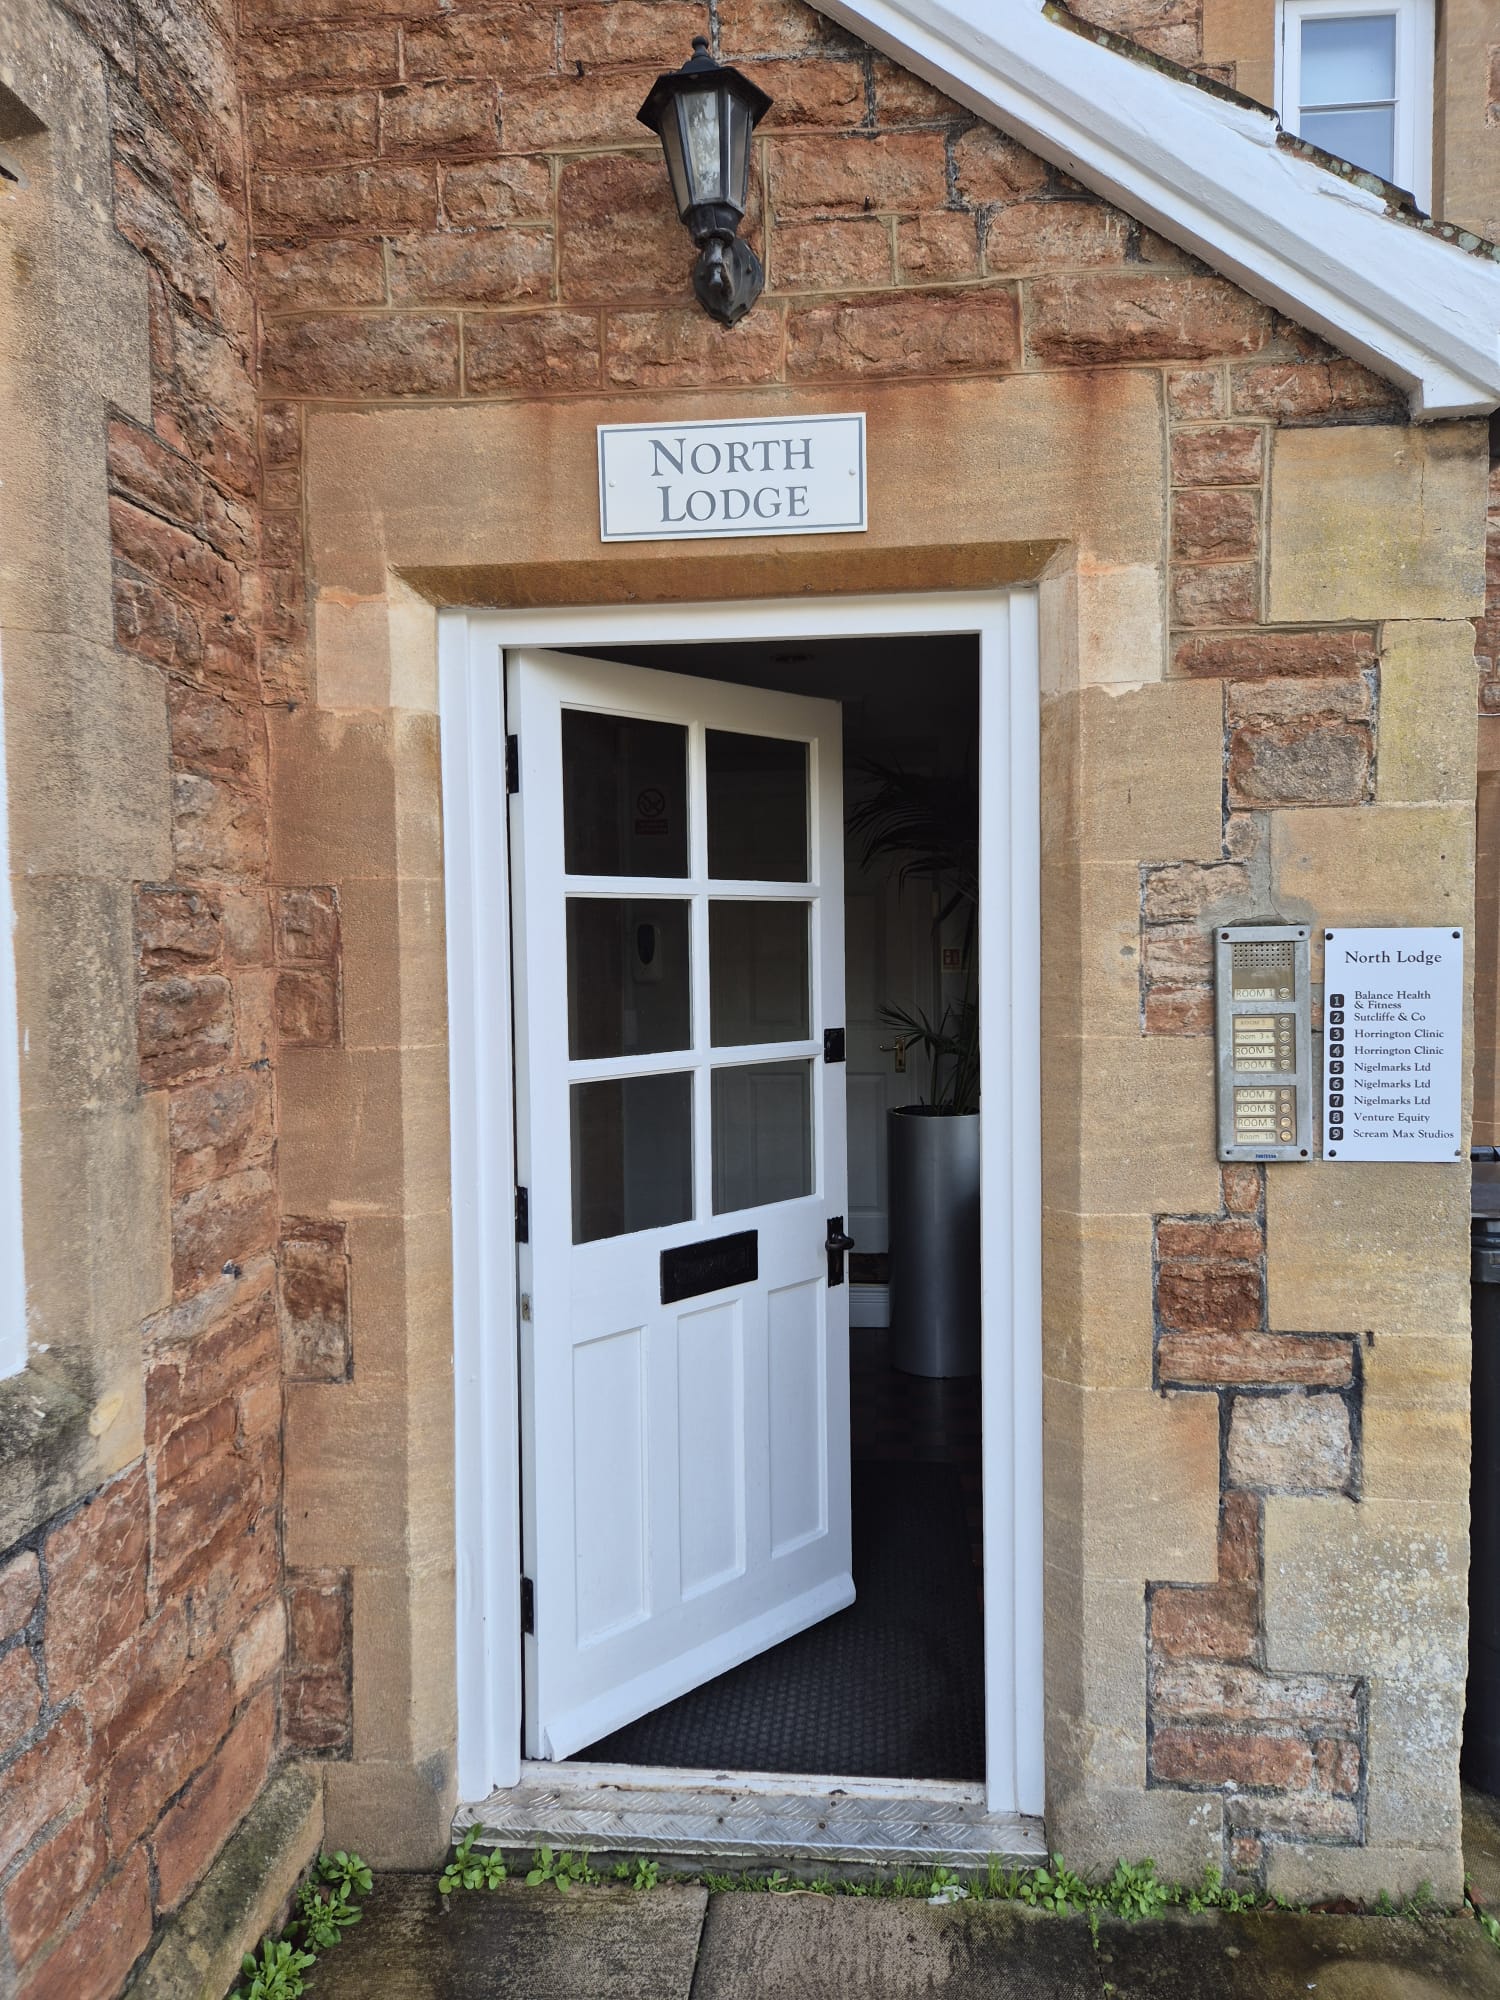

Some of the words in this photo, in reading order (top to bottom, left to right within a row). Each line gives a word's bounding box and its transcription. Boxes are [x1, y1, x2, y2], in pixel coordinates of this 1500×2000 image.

[648, 438, 815, 477] NORTH
[656, 485, 810, 523] LODGE
[1345, 950, 1390, 964] North
[1396, 950, 1442, 965] Lodge
[1236, 989, 1266, 998] ROOM
[1334, 996, 1341, 1006] 1
[1354, 991, 1393, 1000] Balance
[1397, 990, 1431, 1000] Health
[1354, 1000, 1363, 1009] &
[1368, 1000, 1402, 1009] Fitness
[1333, 1012, 1341, 1023] 2
[1354, 1012, 1395, 1021] Sutcliffe
[1398, 1013, 1408, 1021] &
[1411, 1012, 1426, 1021] Co
[1333, 1029, 1341, 1039] 3
[1354, 1029, 1411, 1039] Horrington
[1414, 1029, 1444, 1038] Clinic
[1236, 1047, 1265, 1055] ROOM
[1333, 1046, 1341, 1056] 4
[1354, 1046, 1411, 1056] Horrington
[1414, 1045, 1444, 1055] Clinic
[1333, 1062, 1341, 1073] 5
[1354, 1062, 1411, 1073] Nigelmarks
[1414, 1062, 1431, 1072] Ltd
[1333, 1079, 1341, 1089] 6
[1354, 1079, 1411, 1090] Nigelmarks
[1414, 1079, 1431, 1089] Ltd
[1333, 1095, 1341, 1106] 7
[1354, 1096, 1411, 1106] Nigelmarks
[1414, 1096, 1431, 1105] Ltd
[1236, 1104, 1266, 1112] ROOM
[1238, 1119, 1267, 1127] ROOM
[1332, 1112, 1341, 1122] 8
[1354, 1112, 1395, 1122] Venture
[1397, 1112, 1430, 1123] Equity
[1332, 1128, 1341, 1139] 9
[1353, 1129, 1389, 1138] Scream
[1392, 1129, 1415, 1138] Max
[1417, 1129, 1455, 1139] Studios
